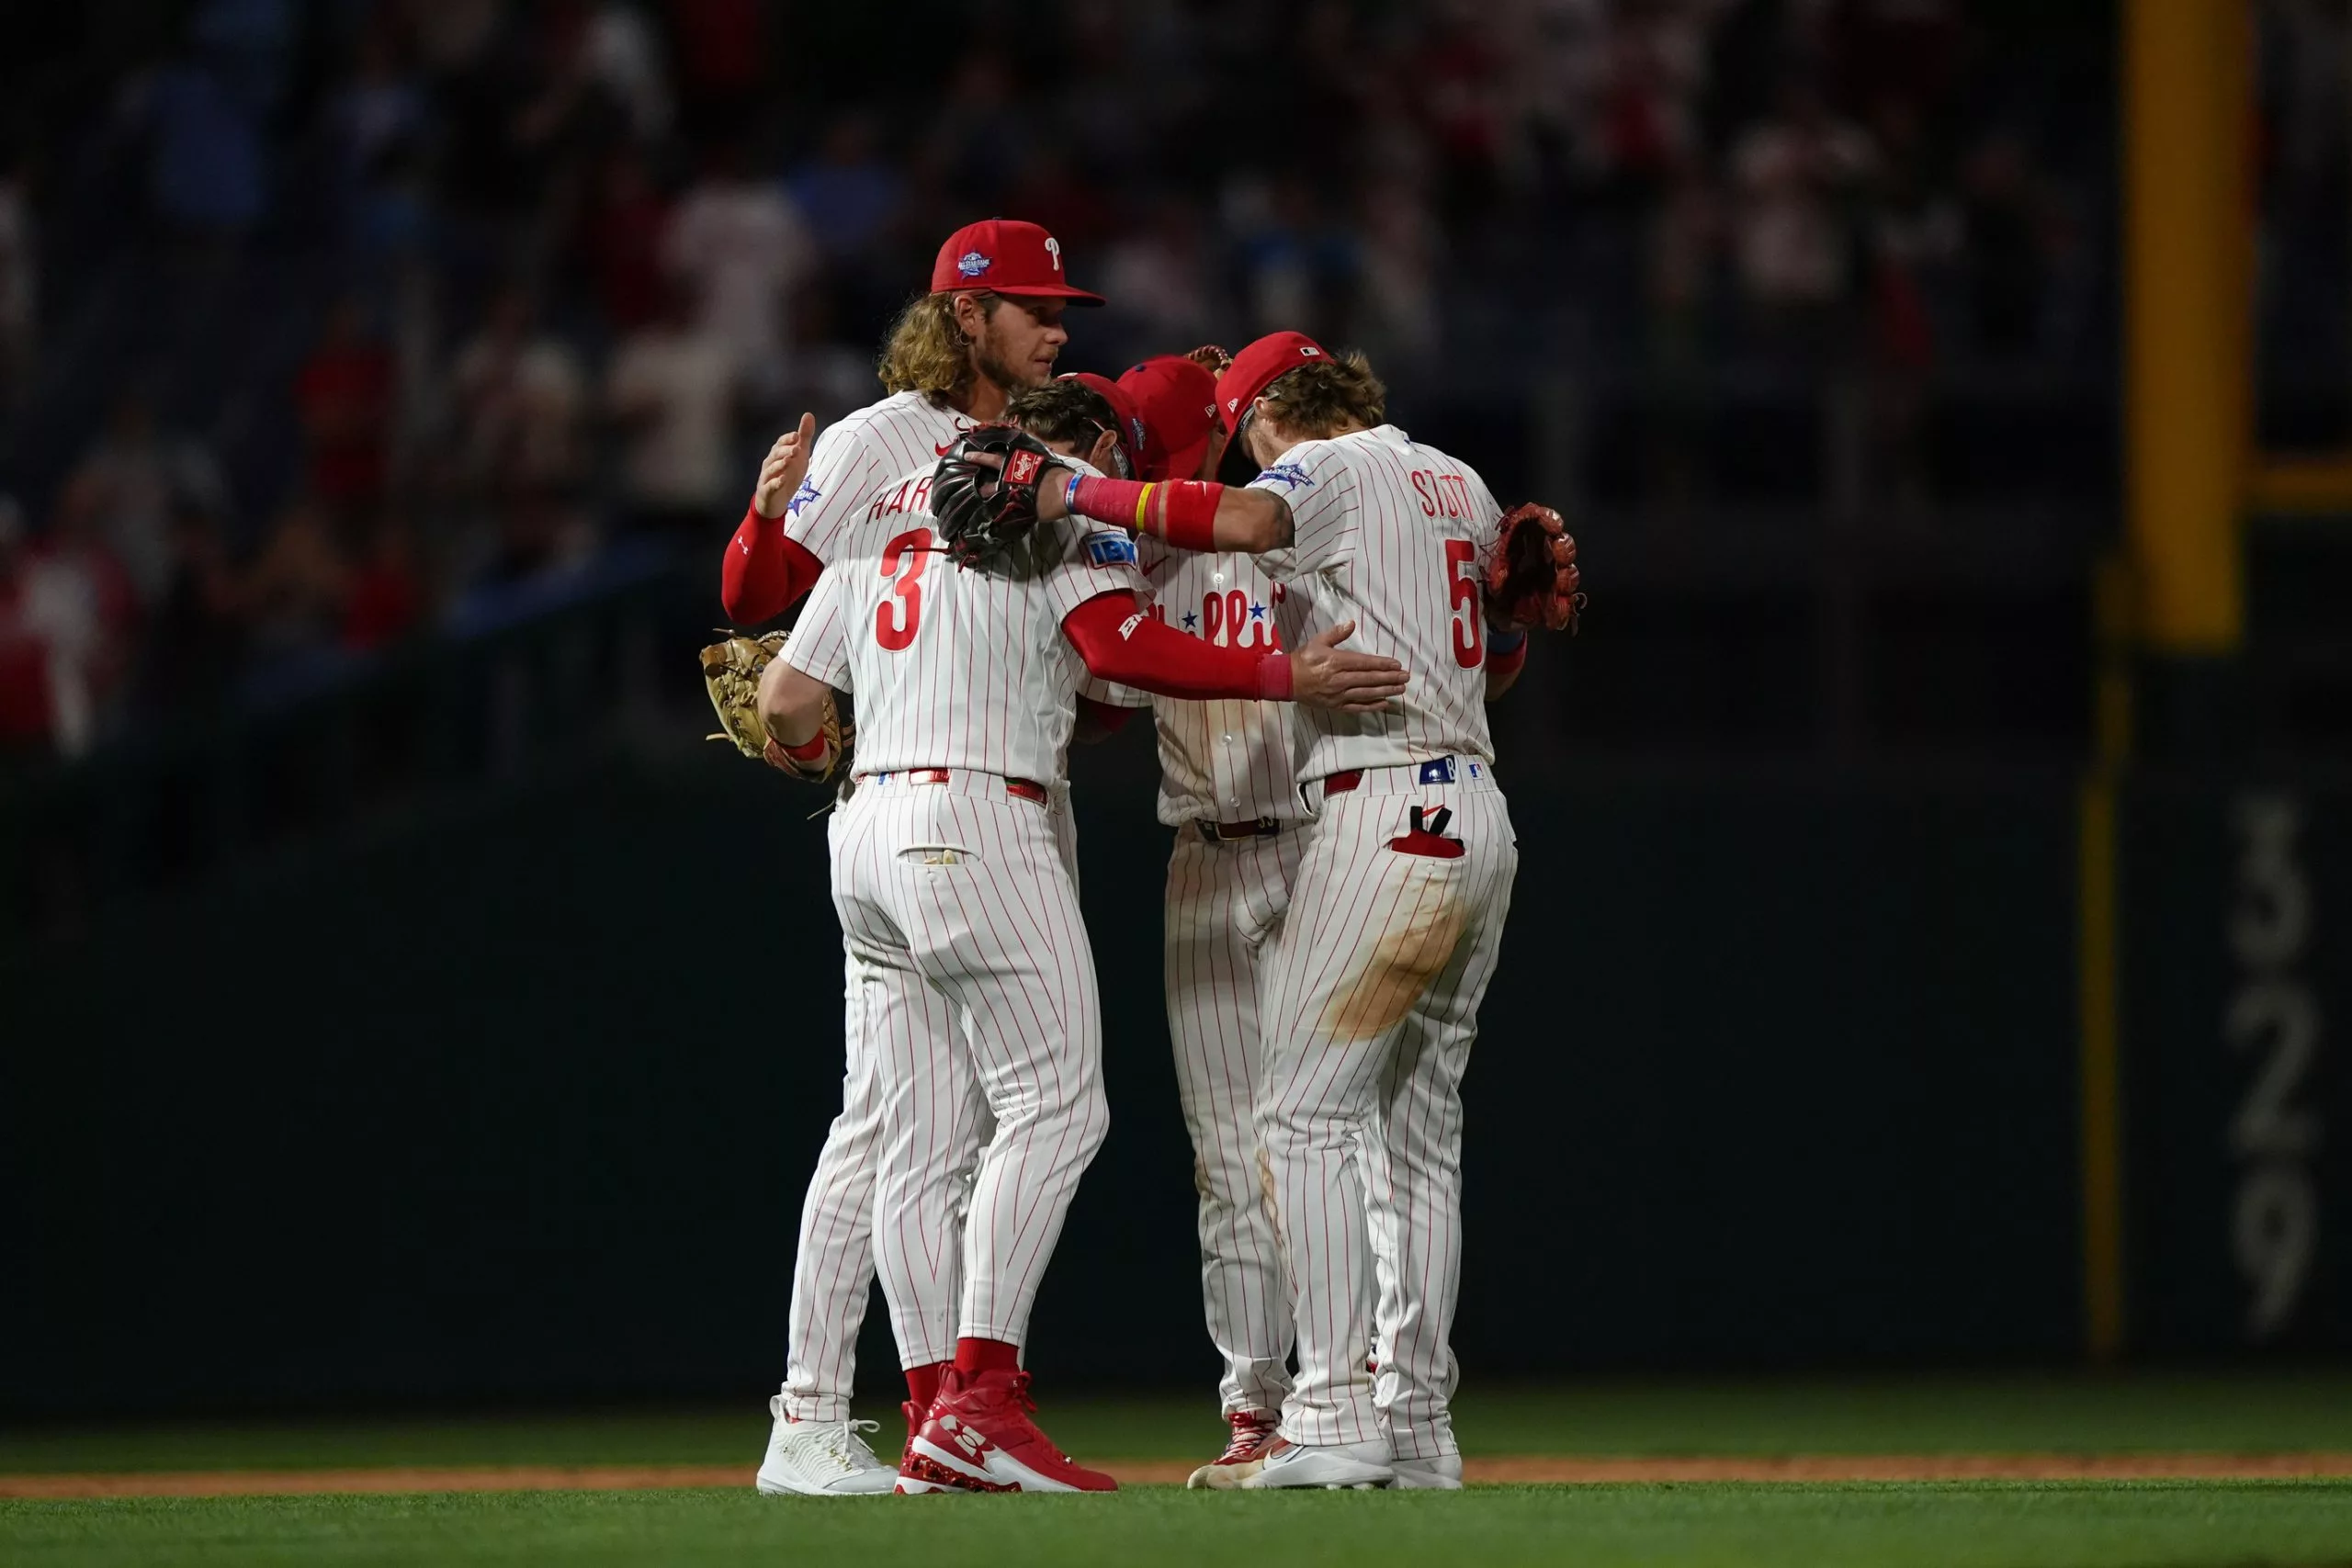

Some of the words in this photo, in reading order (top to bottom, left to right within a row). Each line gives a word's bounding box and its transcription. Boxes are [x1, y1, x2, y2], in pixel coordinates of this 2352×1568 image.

[1045, 237, 1060, 271] P
[865, 476, 933, 525] HAR
[876, 527, 933, 652] 3
[1444, 538, 1485, 669] 5
[2223, 792, 2322, 1341] 329
